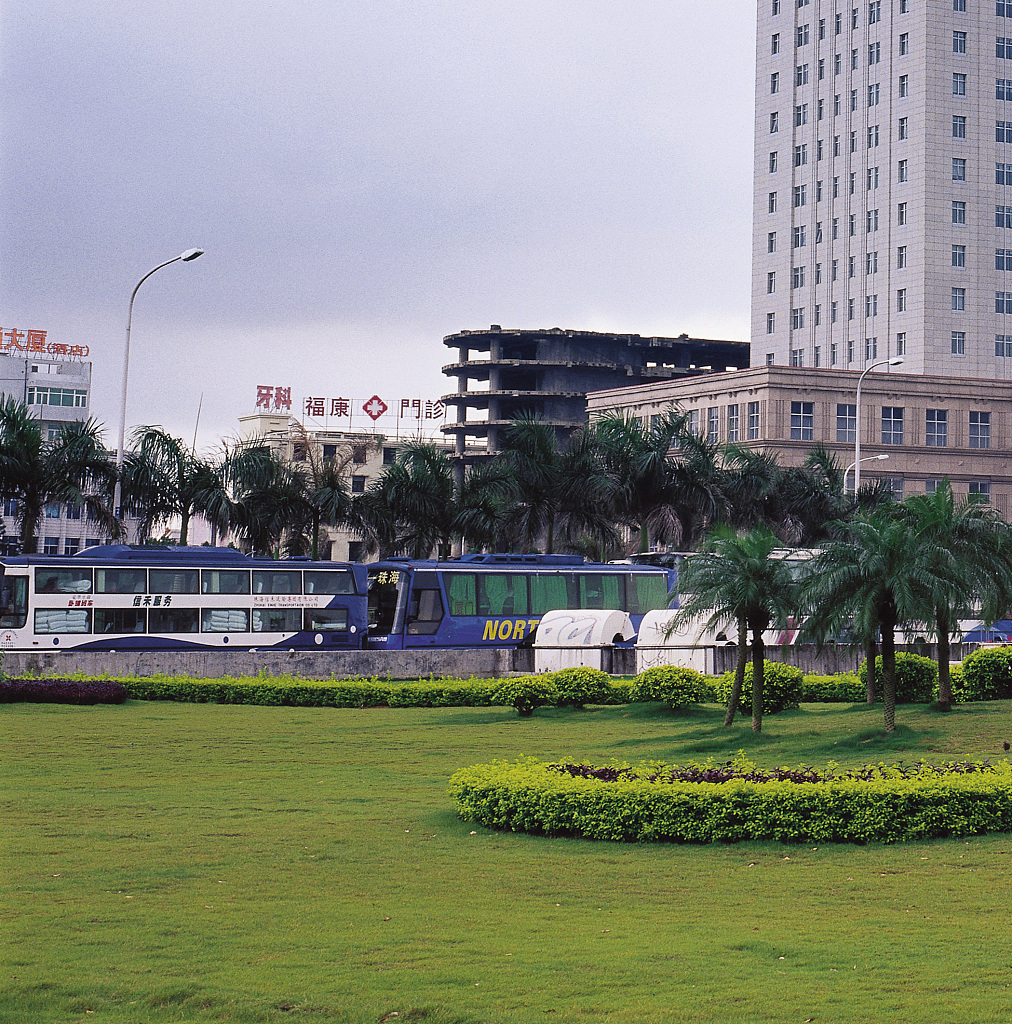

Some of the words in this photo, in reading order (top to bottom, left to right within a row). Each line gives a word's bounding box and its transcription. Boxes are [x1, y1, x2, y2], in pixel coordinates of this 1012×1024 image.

[256, 385, 293, 410] 牙科
[305, 396, 350, 417] 福康
[132, 595, 173, 607] 信禾服务
